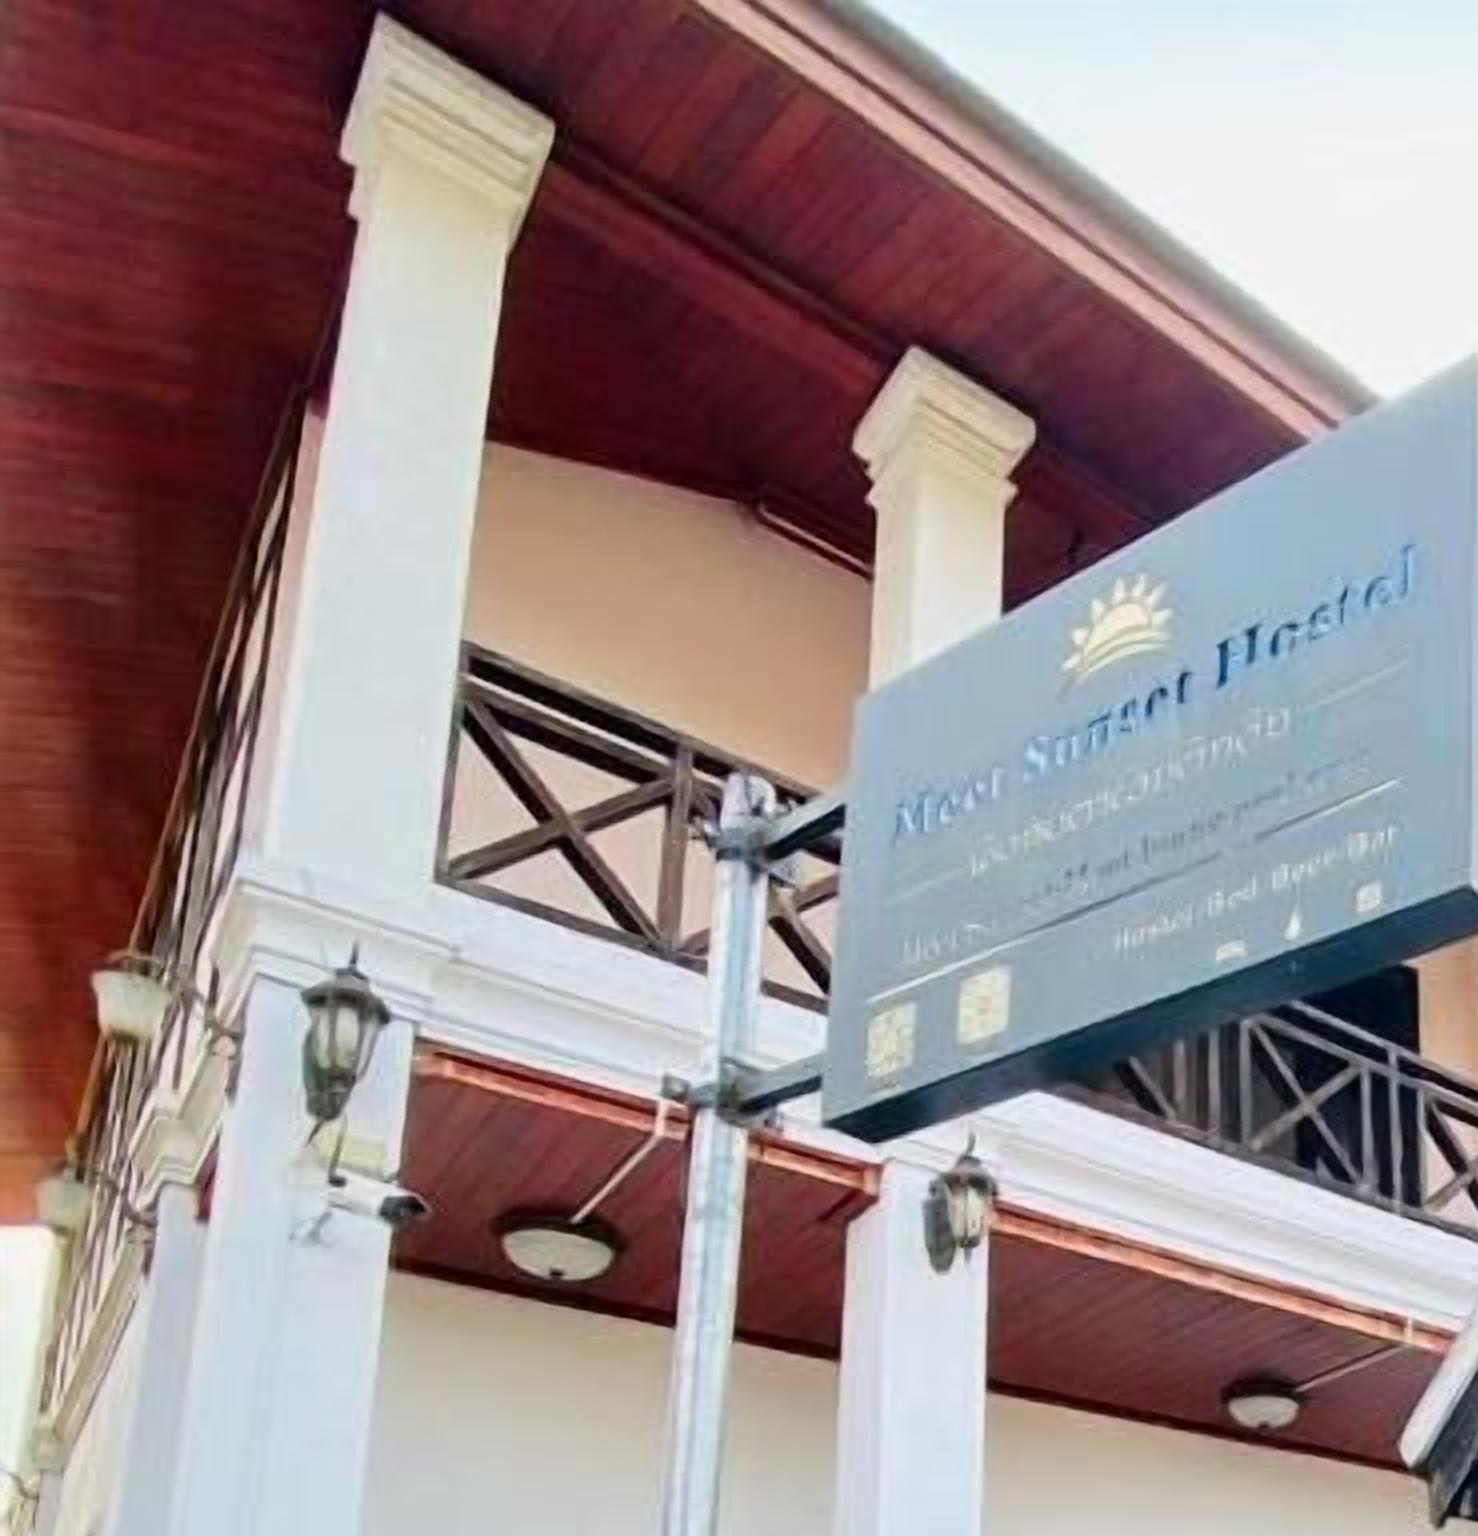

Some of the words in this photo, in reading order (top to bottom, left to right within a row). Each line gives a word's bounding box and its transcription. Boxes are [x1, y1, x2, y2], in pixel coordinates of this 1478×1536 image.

[894, 767, 1005, 846] Meet
[1022, 669, 1195, 784] Sunset
[1214, 543, 1417, 689] Hostel
